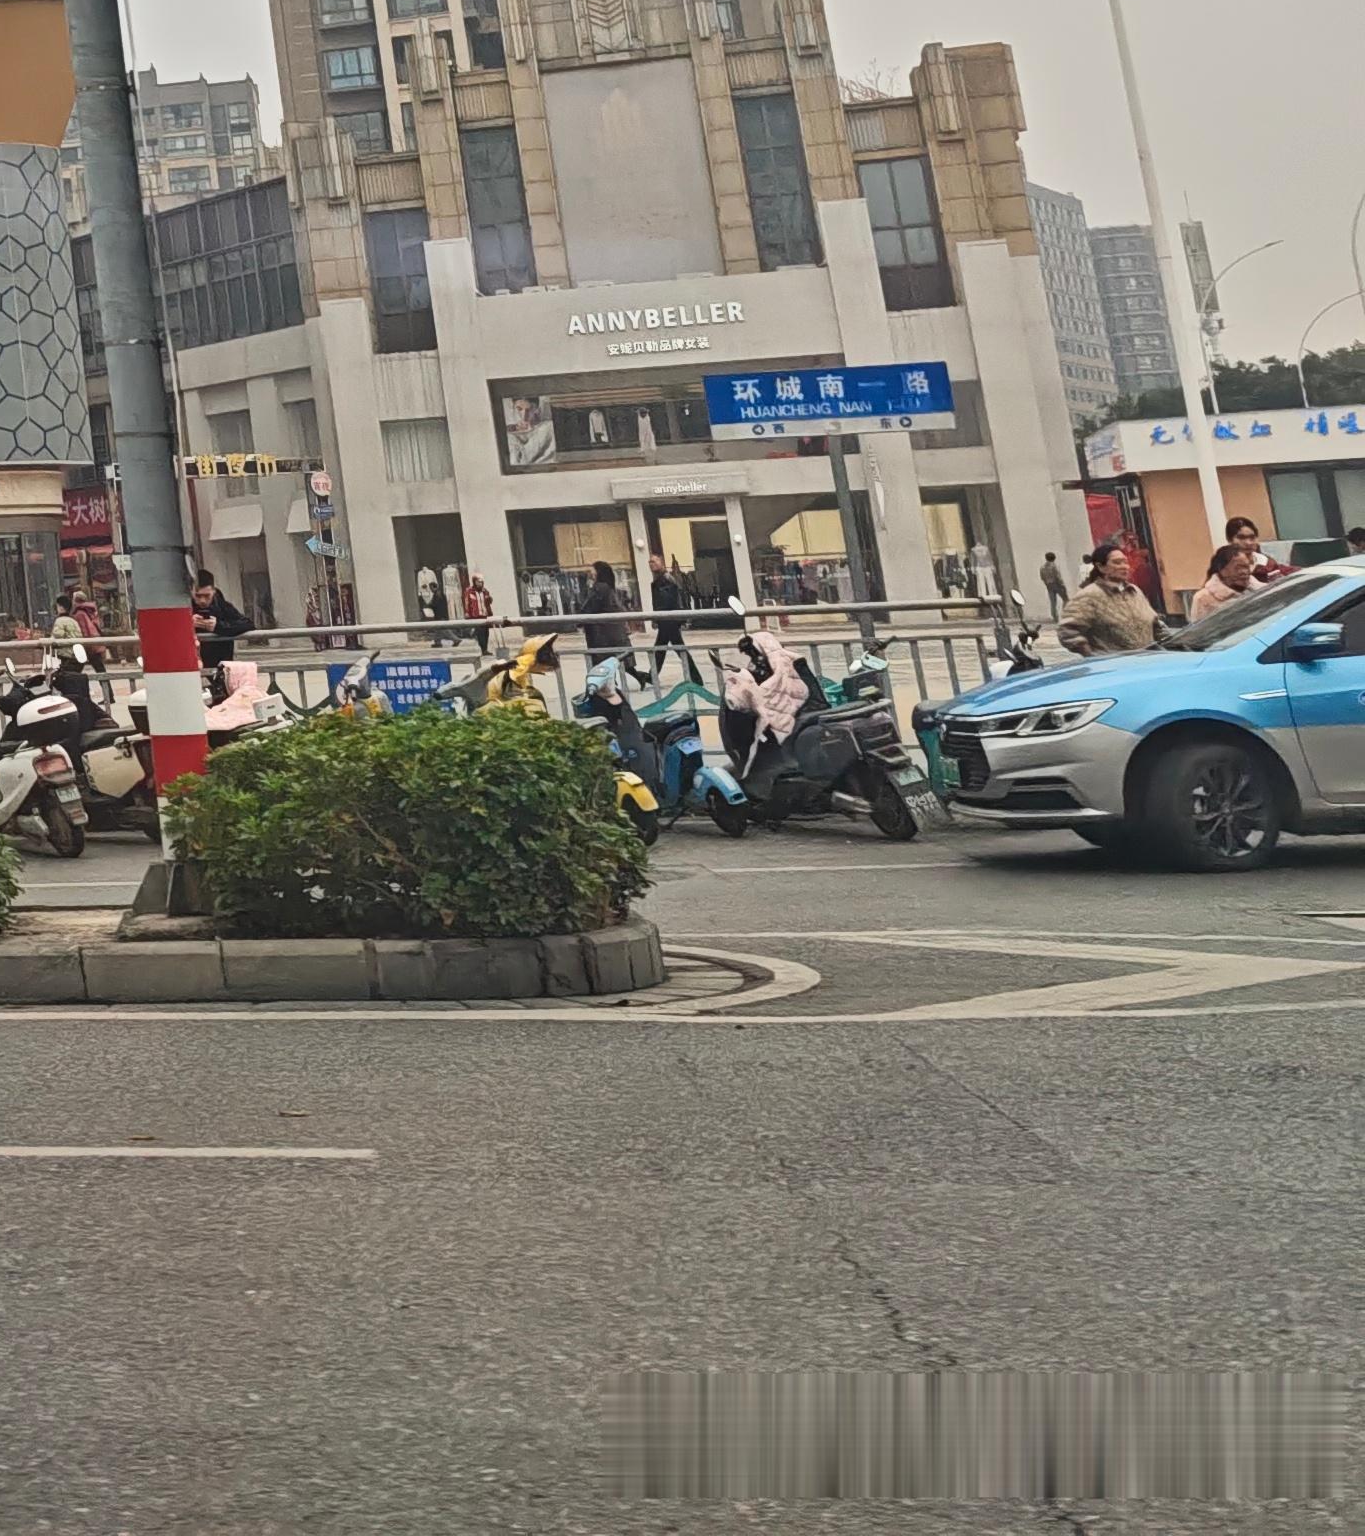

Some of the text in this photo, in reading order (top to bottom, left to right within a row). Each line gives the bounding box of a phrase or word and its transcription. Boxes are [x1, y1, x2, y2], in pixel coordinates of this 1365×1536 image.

[567, 300, 745, 336] ANNYBELLER
[606, 336, 711, 357] 安妮贝勒品牌女装
[731, 370, 931, 404] 环城南一路
[740, 401, 832, 420] HUANCHENG
[839, 398, 873, 414] NAN
[880, 418, 892, 430] 东
[61, 495, 112, 527] 大树
